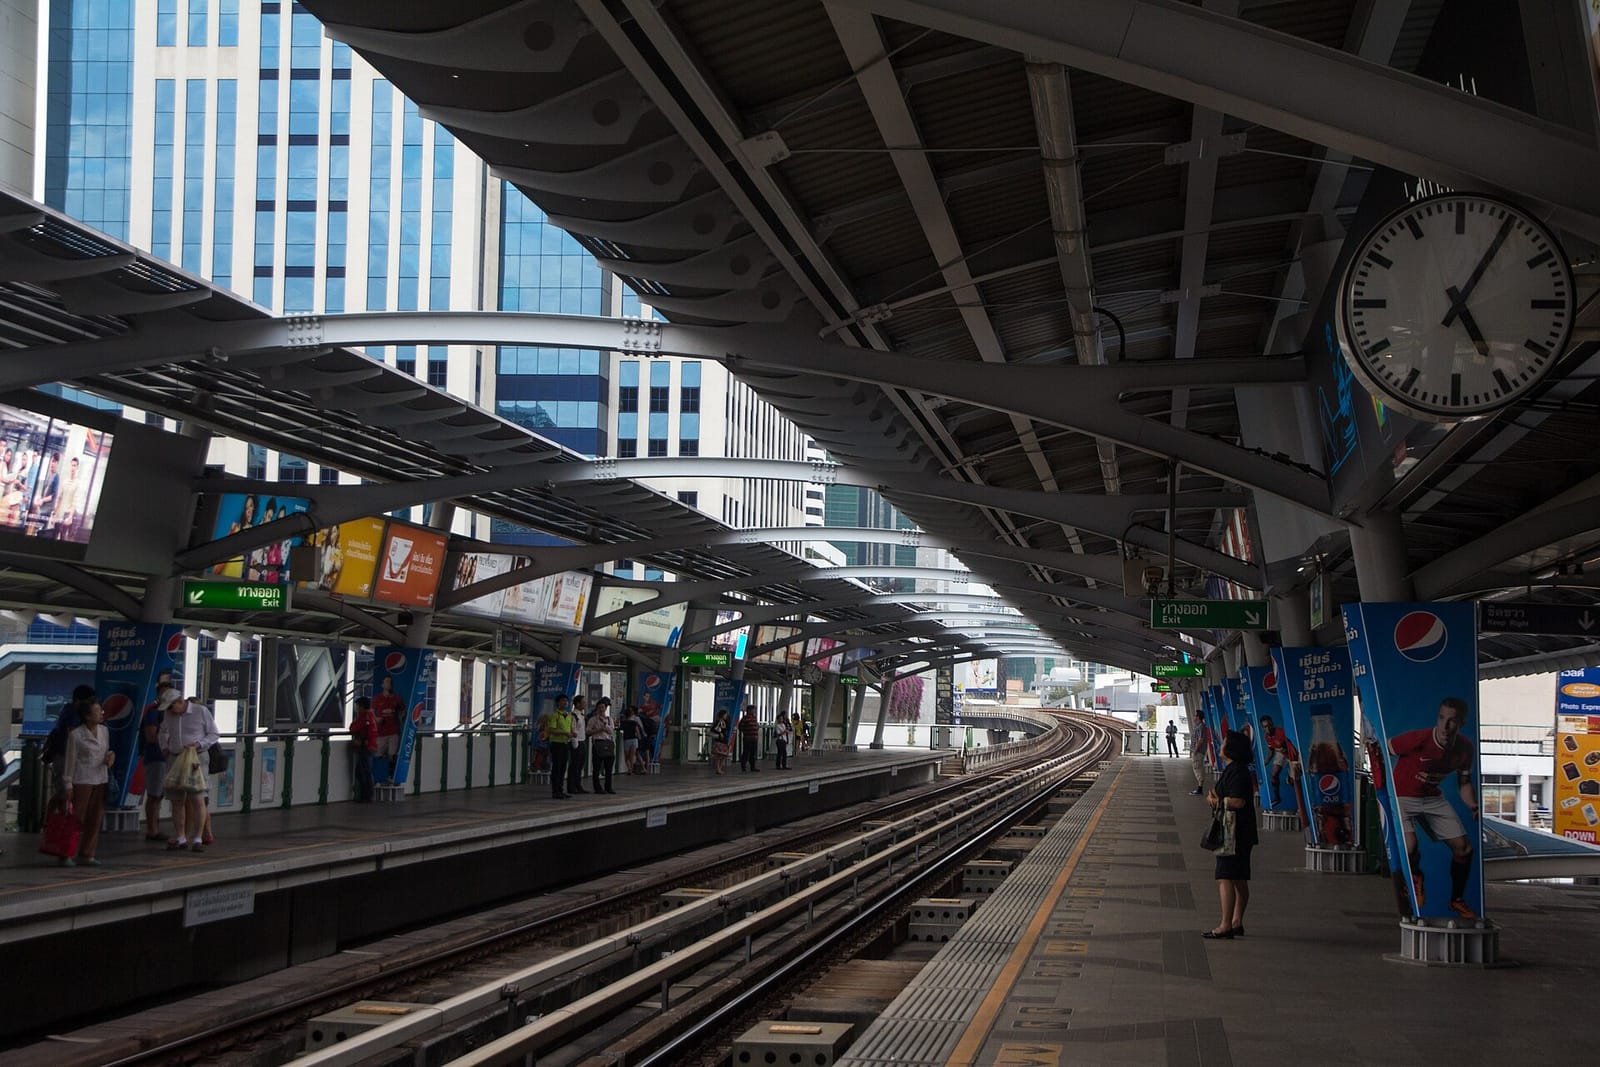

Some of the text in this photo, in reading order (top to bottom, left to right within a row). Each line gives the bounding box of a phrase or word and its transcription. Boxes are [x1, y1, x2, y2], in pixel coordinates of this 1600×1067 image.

[238, 586, 280, 598] ทางออก
[262, 598, 280, 607] Exit
[1160, 603, 1208, 615] ทางออก
[1162, 615, 1182, 624] Exit
[1564, 831, 1596, 843] DOWN
